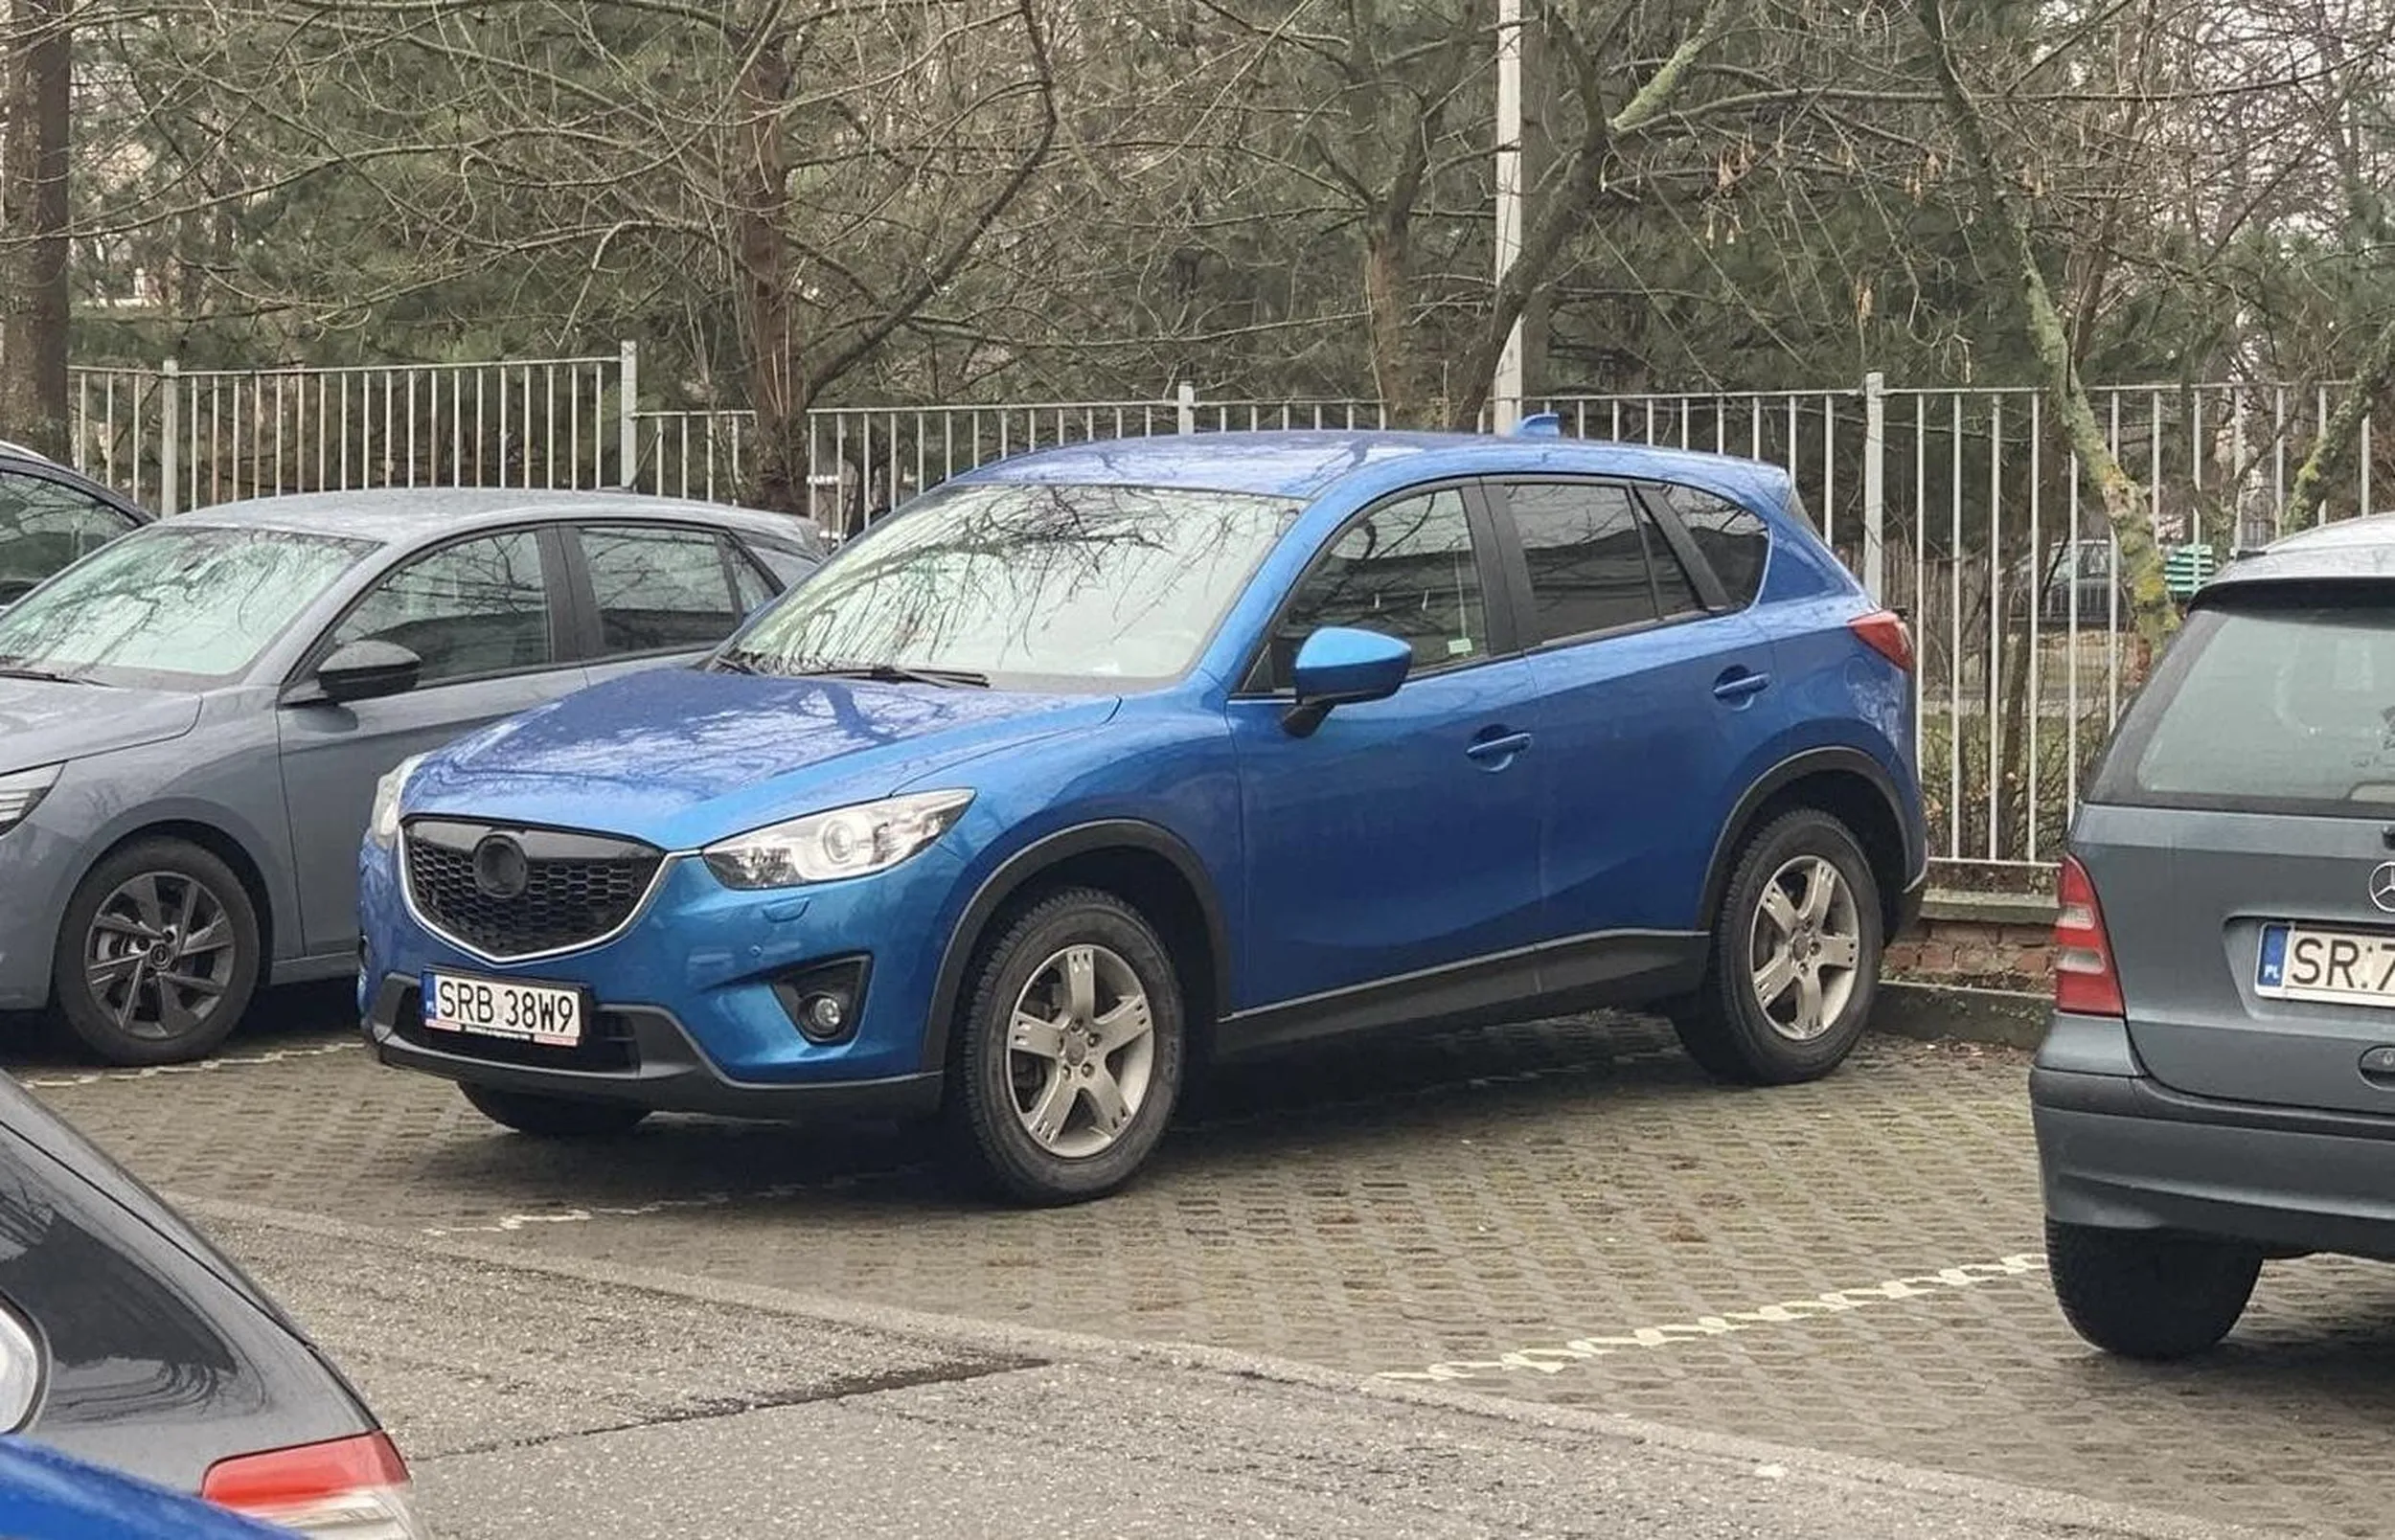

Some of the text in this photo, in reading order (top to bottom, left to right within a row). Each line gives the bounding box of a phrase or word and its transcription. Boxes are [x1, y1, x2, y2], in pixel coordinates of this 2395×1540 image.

[2264, 964, 2280, 980] PL
[2292, 938, 2359, 988] SR
[440, 981, 574, 1032] SRB 38W9
